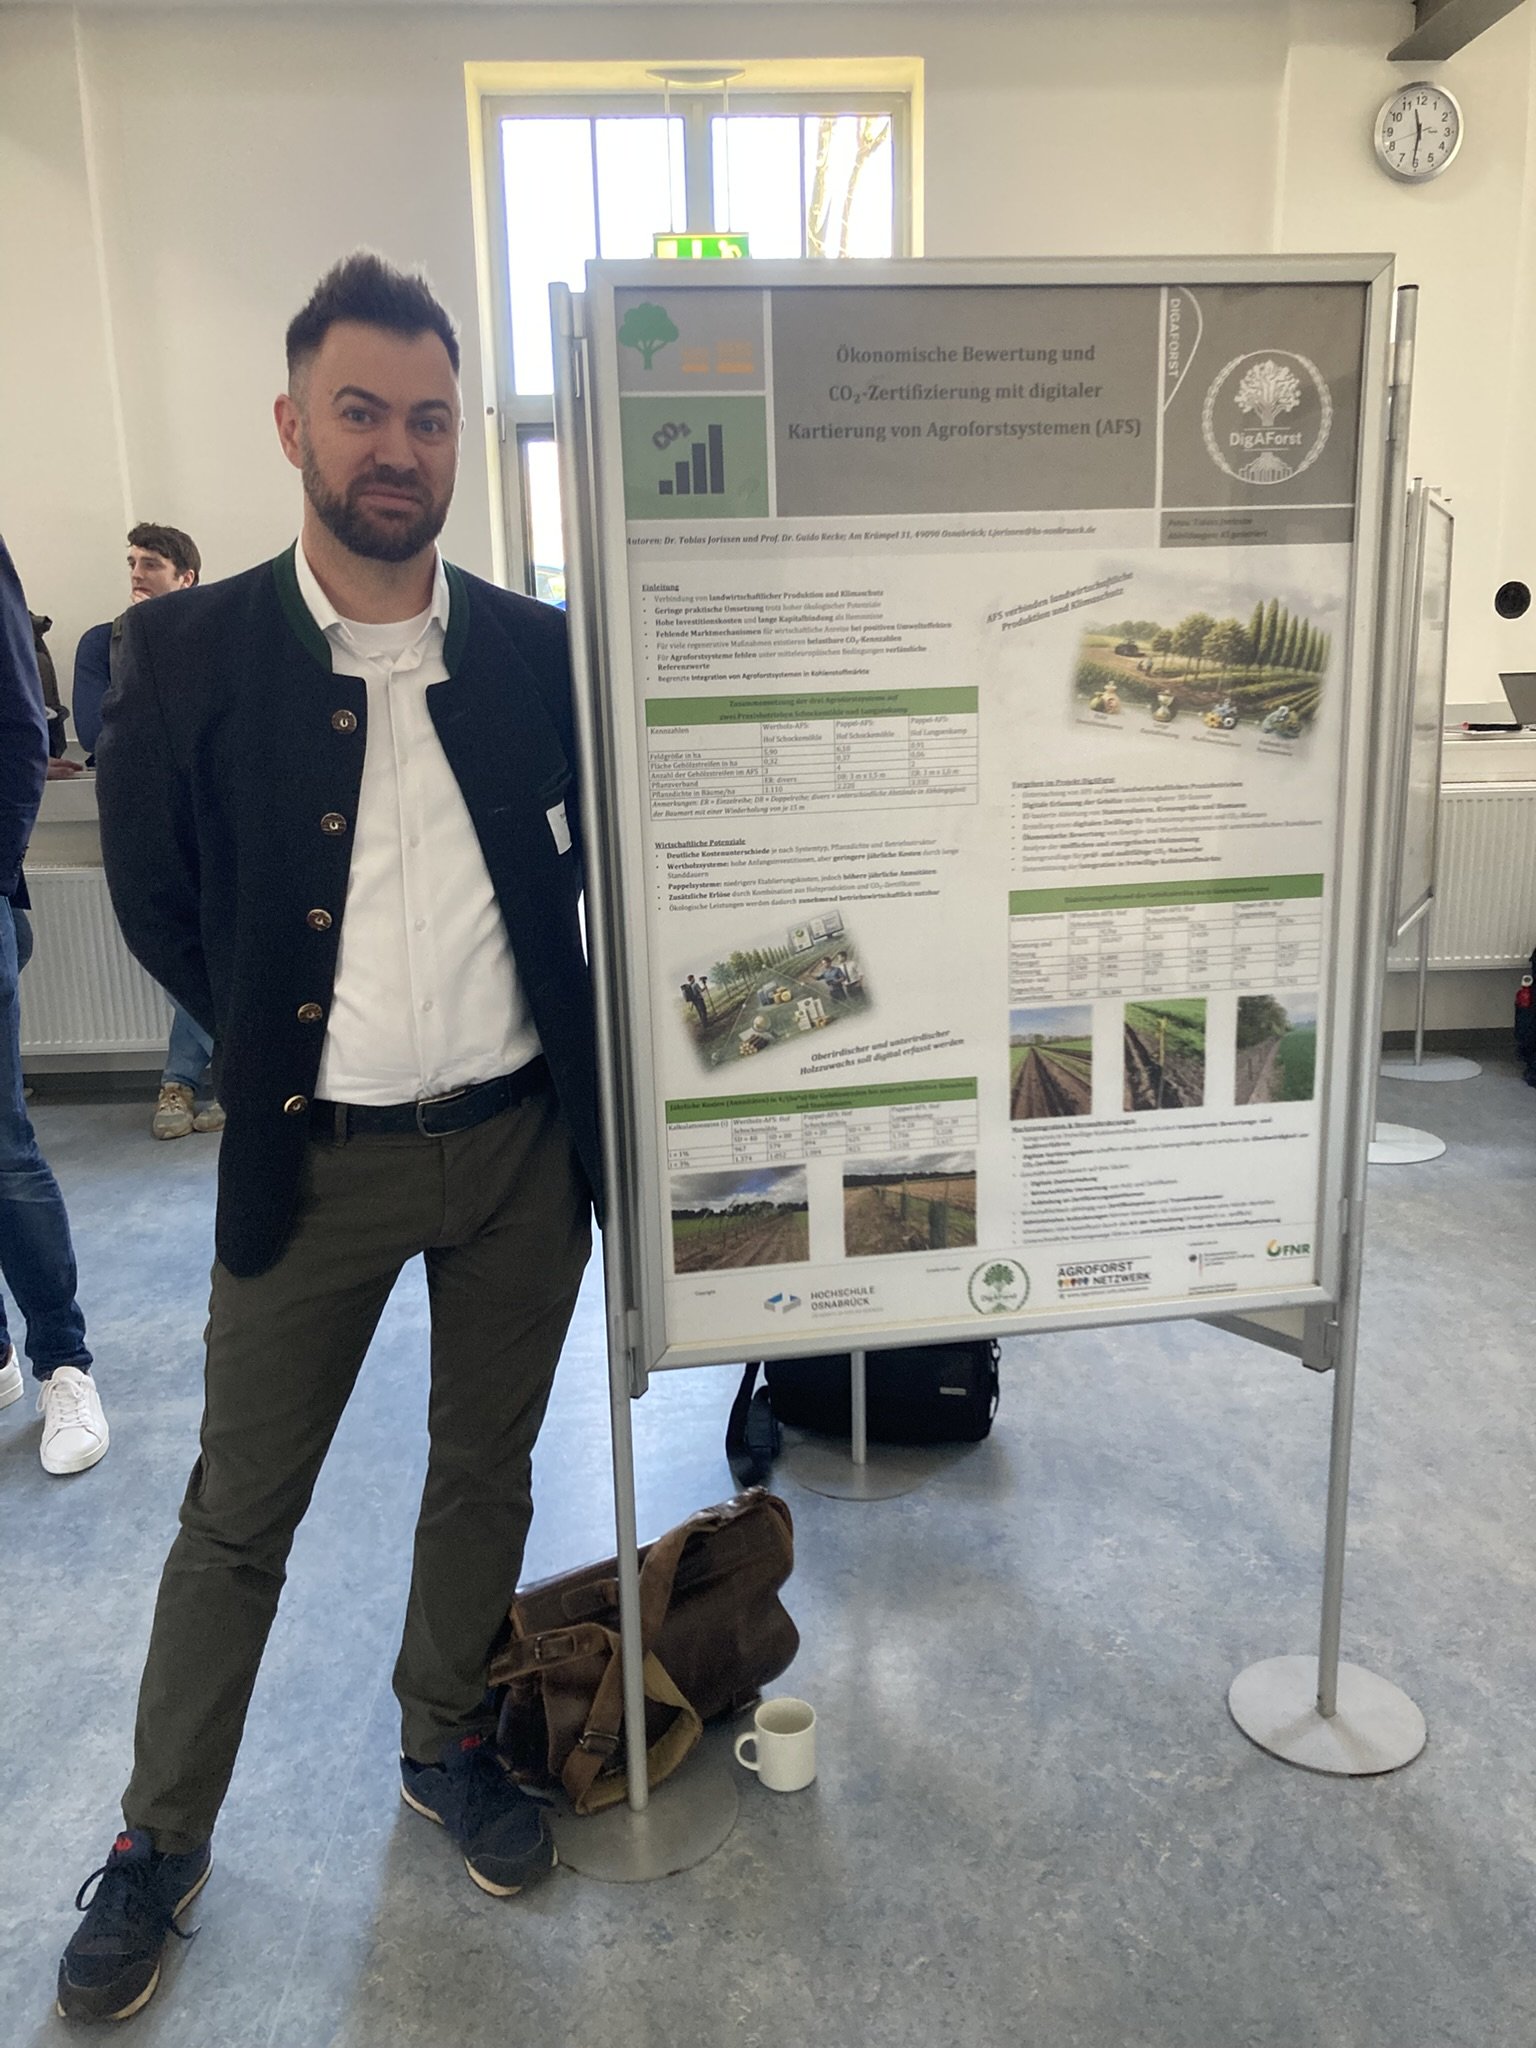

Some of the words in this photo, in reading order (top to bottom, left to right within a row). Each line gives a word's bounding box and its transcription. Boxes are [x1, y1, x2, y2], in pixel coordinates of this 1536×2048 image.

[1402, 101, 1412, 111] 11
[1416, 95, 1428, 106] 12
[1433, 101, 1437, 111] 1
[1392, 112, 1402, 122] 10
[1441, 112, 1449, 122] 2
[1386, 127, 1394, 137] 9
[1443, 127, 1451, 137] 3
[1389, 141, 1396, 151] 8
[1438, 141, 1445, 150] 4
[1399, 153, 1405, 162] 7
[1413, 158, 1419, 168] 6
[1427, 152, 1434, 163] 5
[1168, 298, 1181, 379] DIGAFORST
[836, 345, 959, 364] Ökonomische
[962, 346, 1058, 364] Bewertung
[1061, 345, 1096, 362] und
[995, 383, 1025, 400] mit
[1029, 382, 1103, 404] digitaler
[788, 422, 887, 442] Kartierung
[891, 425, 921, 439] von
[925, 420, 1091, 441] Agroforstsystemen
[1096, 418, 1141, 438] (AFS)
[1229, 431, 1302, 449] DigAForst
[627, 536, 662, 545] Autoren:
[664, 536, 677, 544] Dr.
[679, 535, 706, 544] Tobias
[707, 535, 741, 543] Jorissen
[743, 534, 759, 542] und
[761, 533, 780, 542] Prof.
[782, 533, 794, 541] Dr.
[642, 584, 680, 592] Einleitung
[783, 592, 823, 600] Produktion
[655, 606, 683, 615] Geringe
[684, 605, 723, 615] praktische
[724, 604, 764, 613] Umsetzung
[655, 618, 674, 626] Hohe
[676, 616, 742, 625] Investitionskosten
[656, 629, 689, 637] Fehlende
[690, 628, 761, 636] Marktmechanismen
[670, 651, 733, 662] Agroforstsysteme
[735, 650, 757, 658] fehlen
[655, 839, 708, 849] Wirtschaftliche
[709, 838, 746, 847] Potenziale
[666, 850, 700, 859] Deutliche
[701, 847, 770, 857] Kostenunterschiede
[811, 1044, 869, 1062] Oberirdischer
[872, 1041, 888, 1050] und
[1282, 1243, 1310, 1256] FNR
[1057, 1261, 1133, 1277] AGROFORST
[1092, 1272, 1152, 1285] NETZWERK
[810, 1286, 875, 1300] HOCHSCHULE
[811, 1297, 871, 1311] OSNABRÜCK
